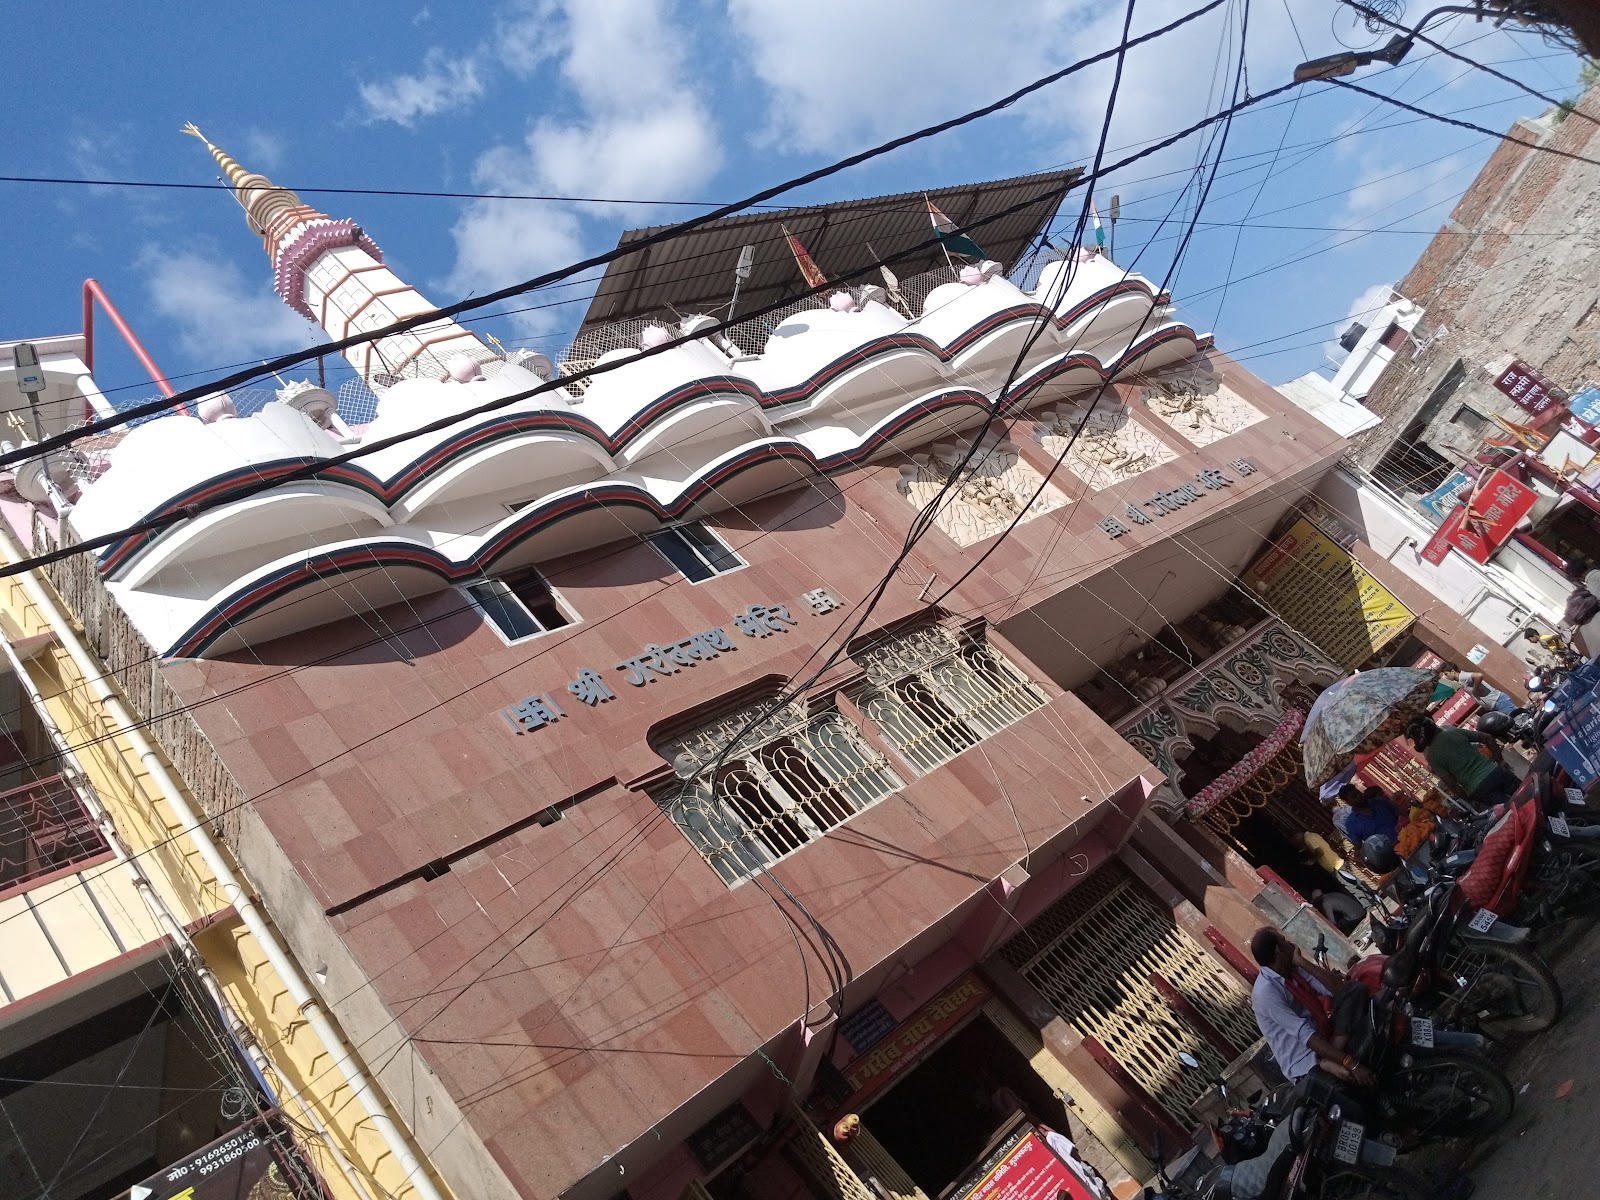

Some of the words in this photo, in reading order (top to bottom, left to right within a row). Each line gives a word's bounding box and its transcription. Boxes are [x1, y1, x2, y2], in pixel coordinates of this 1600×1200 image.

[1125, 502, 1153, 525] श्री
[1144, 480, 1207, 517] गरीबनाथ
[1196, 468, 1234, 490] मंदिर
[1458, 533, 1477, 550] श्री
[1493, 482, 1522, 507] मंदिर
[568, 667, 615, 704] श्री
[616, 626, 737, 687] गरीबनाथ
[735, 603, 798, 637] मंदिर
[1480, 914, 1496, 931] 5456
